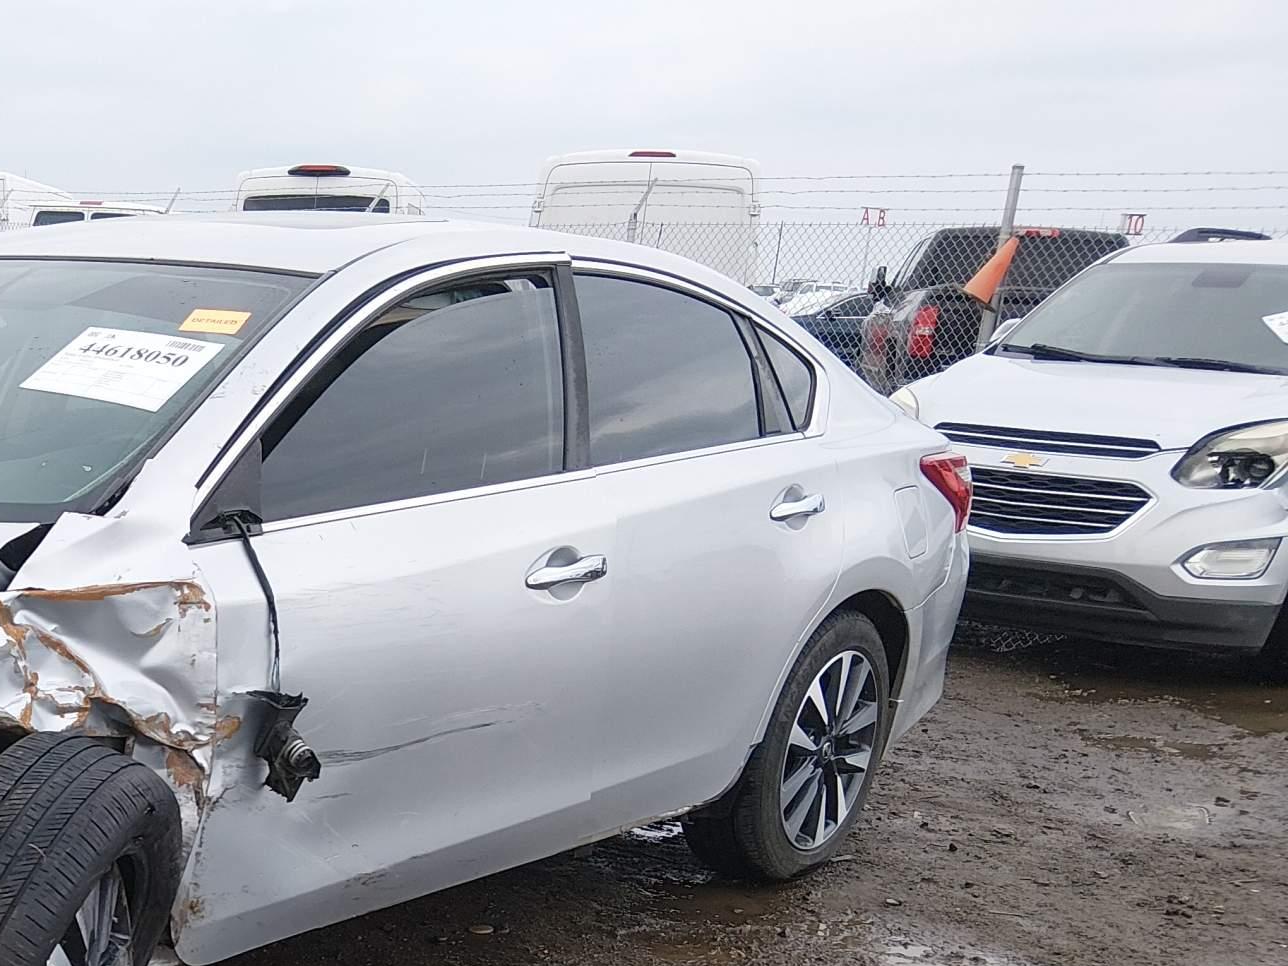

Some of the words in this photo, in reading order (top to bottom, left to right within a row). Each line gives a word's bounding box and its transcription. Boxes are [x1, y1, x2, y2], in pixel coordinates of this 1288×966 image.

[859, 207, 870, 225] A
[877, 209, 886, 227] B
[1127, 214, 1145, 235] 10
[191, 317, 238, 326] DETAILED
[79, 342, 189, 367] 44618050
